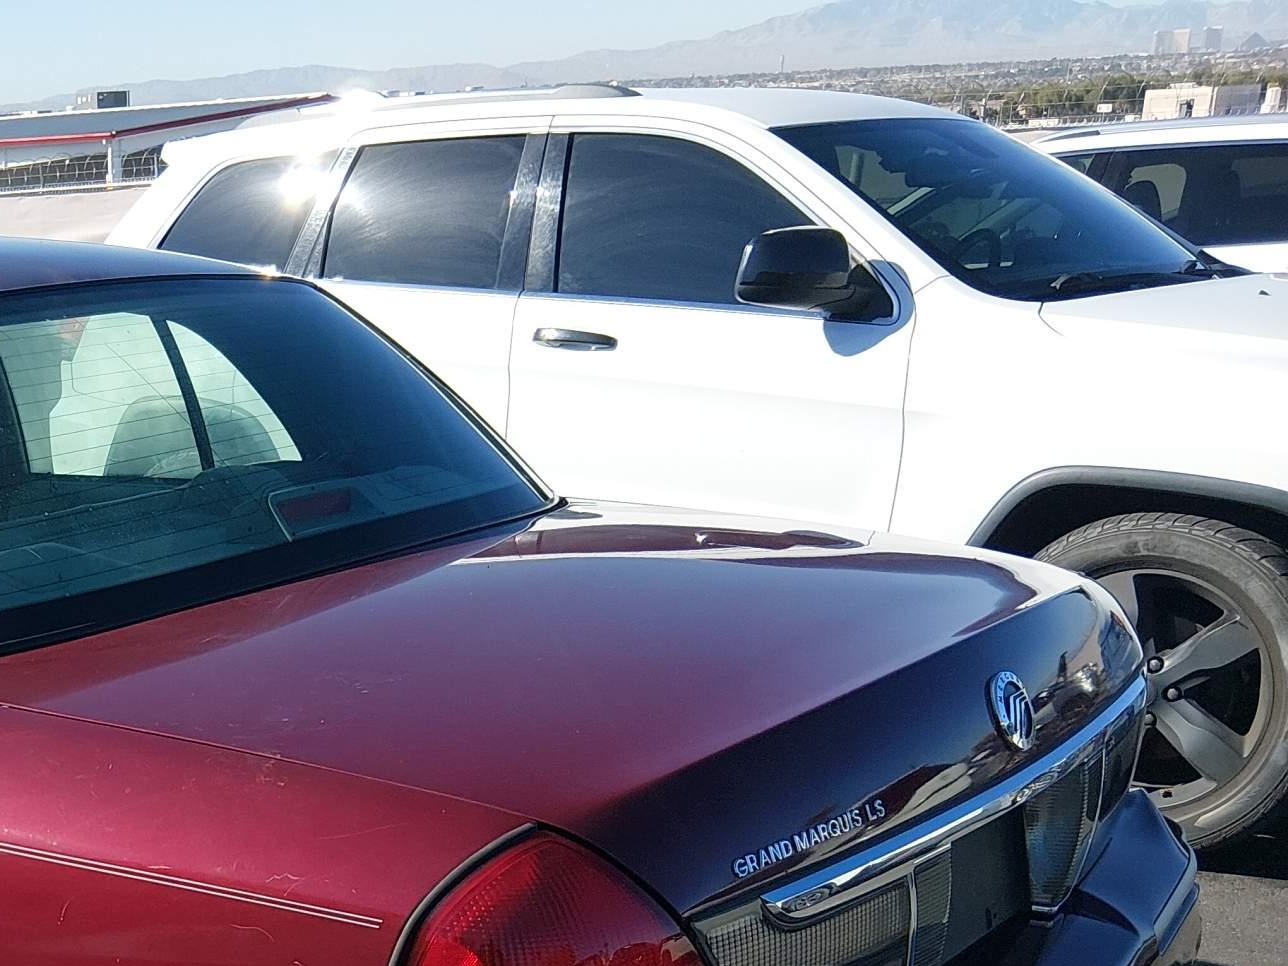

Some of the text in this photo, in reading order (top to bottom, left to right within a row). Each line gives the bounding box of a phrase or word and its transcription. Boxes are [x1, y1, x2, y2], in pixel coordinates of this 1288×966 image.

[734, 799, 886, 877] GRAND MARQUIS LS
